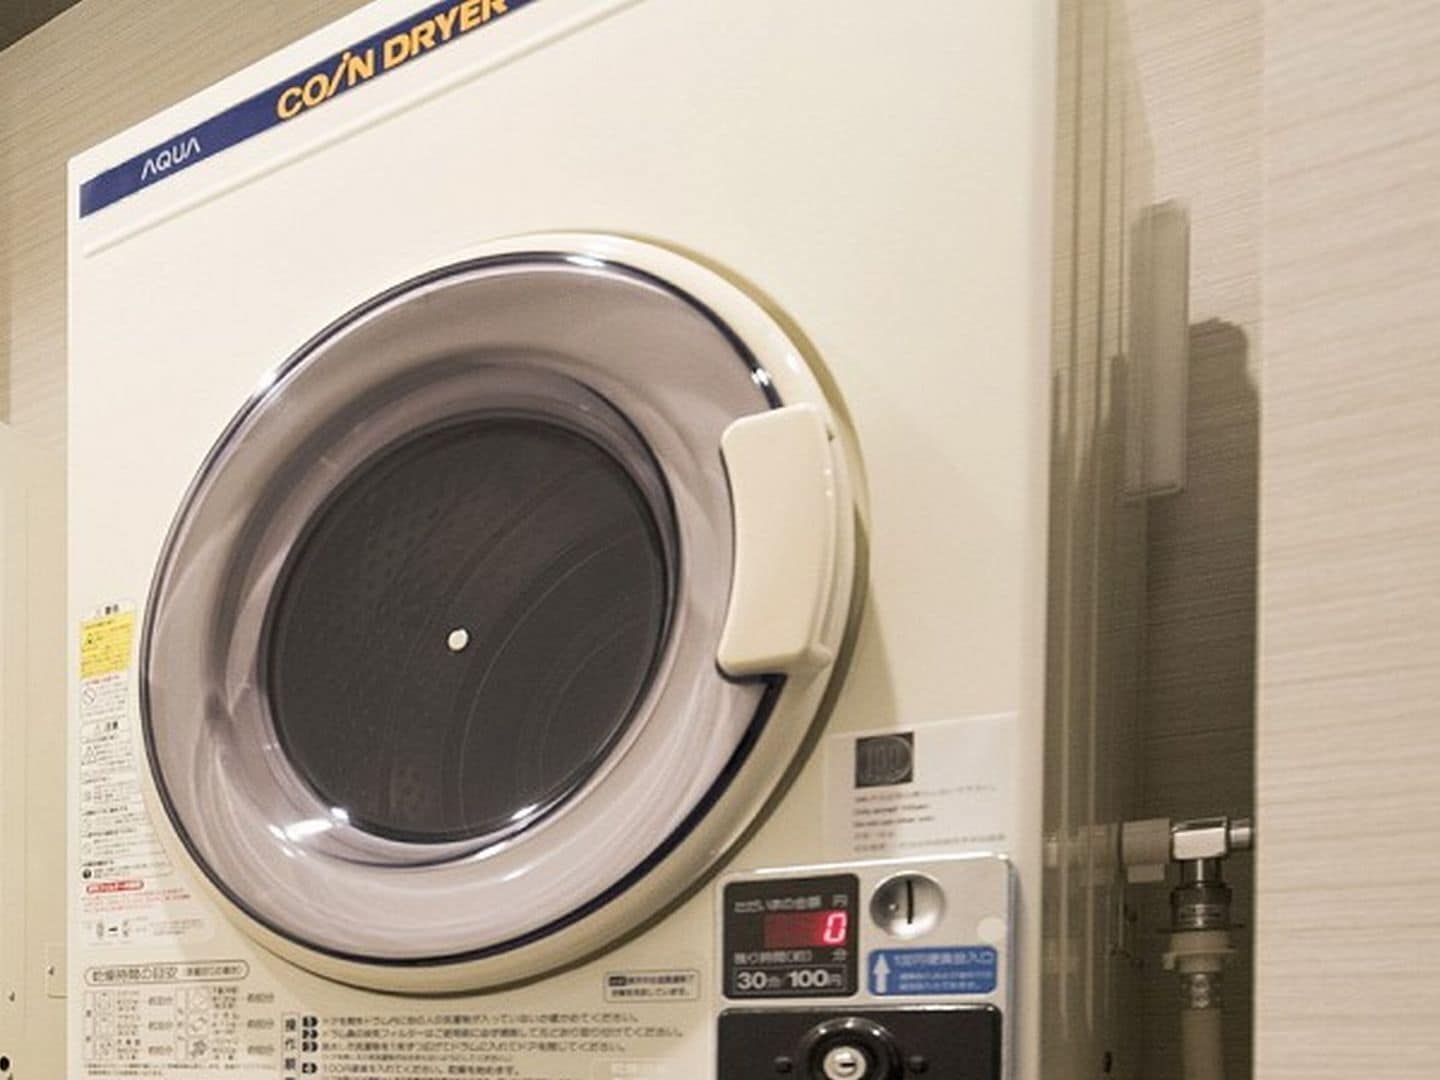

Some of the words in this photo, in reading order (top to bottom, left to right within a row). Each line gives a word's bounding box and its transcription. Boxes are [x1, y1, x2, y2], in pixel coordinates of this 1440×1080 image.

[141, 136, 201, 181] AQUA
[383, 0, 511, 70] DRYER
[823, 911, 847, 944] 0
